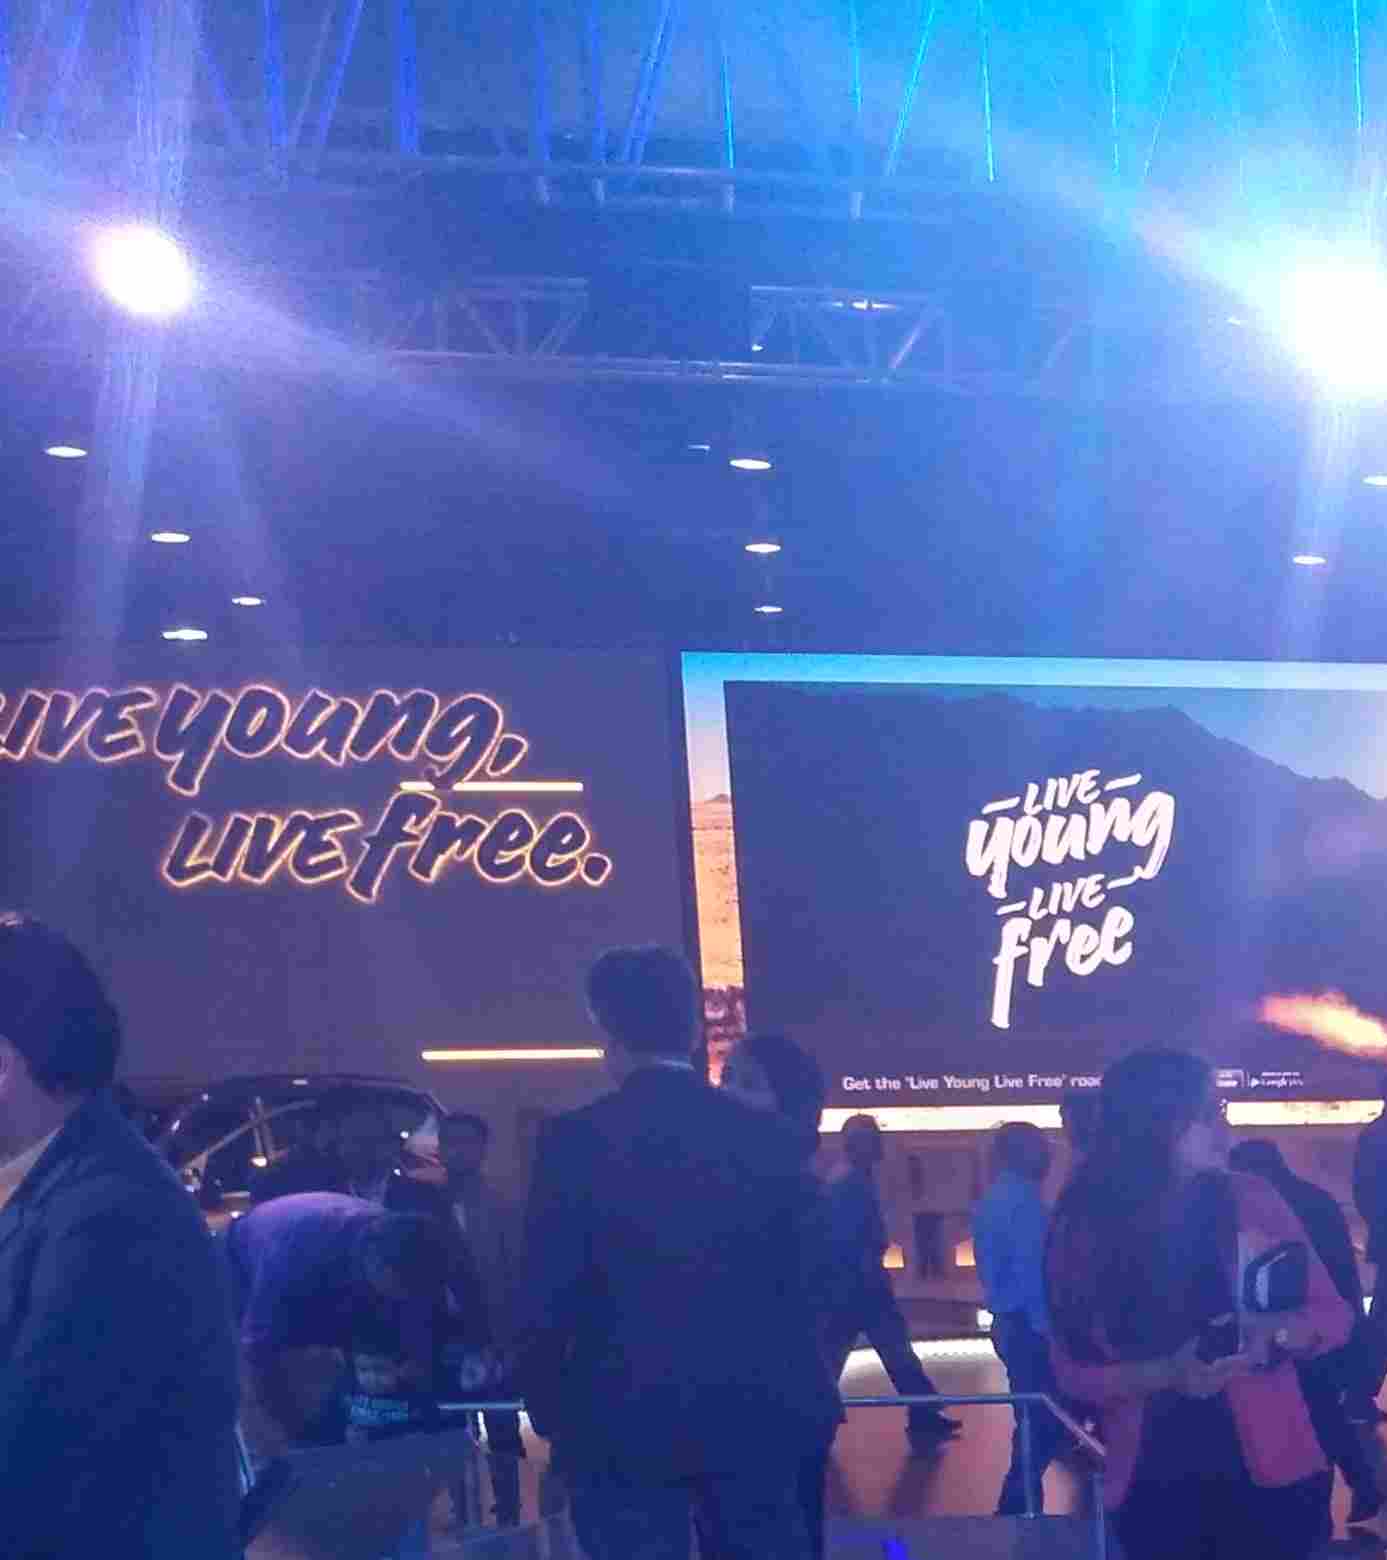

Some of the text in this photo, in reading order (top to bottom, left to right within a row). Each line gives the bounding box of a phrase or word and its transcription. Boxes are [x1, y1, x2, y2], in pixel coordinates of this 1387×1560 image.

[0, 686, 159, 763] IVE
[1023, 769, 1101, 816] LIVE
[162, 790, 612, 901] LIVE free.
[965, 791, 1175, 899] young
[1027, 873, 1106, 921] LIVE
[991, 905, 1135, 1030] free
[842, 1076, 873, 1092] Get
[876, 1076, 901, 1090] the
[943, 1074, 990, 1092] Young
[994, 1074, 1023, 1090] Live
